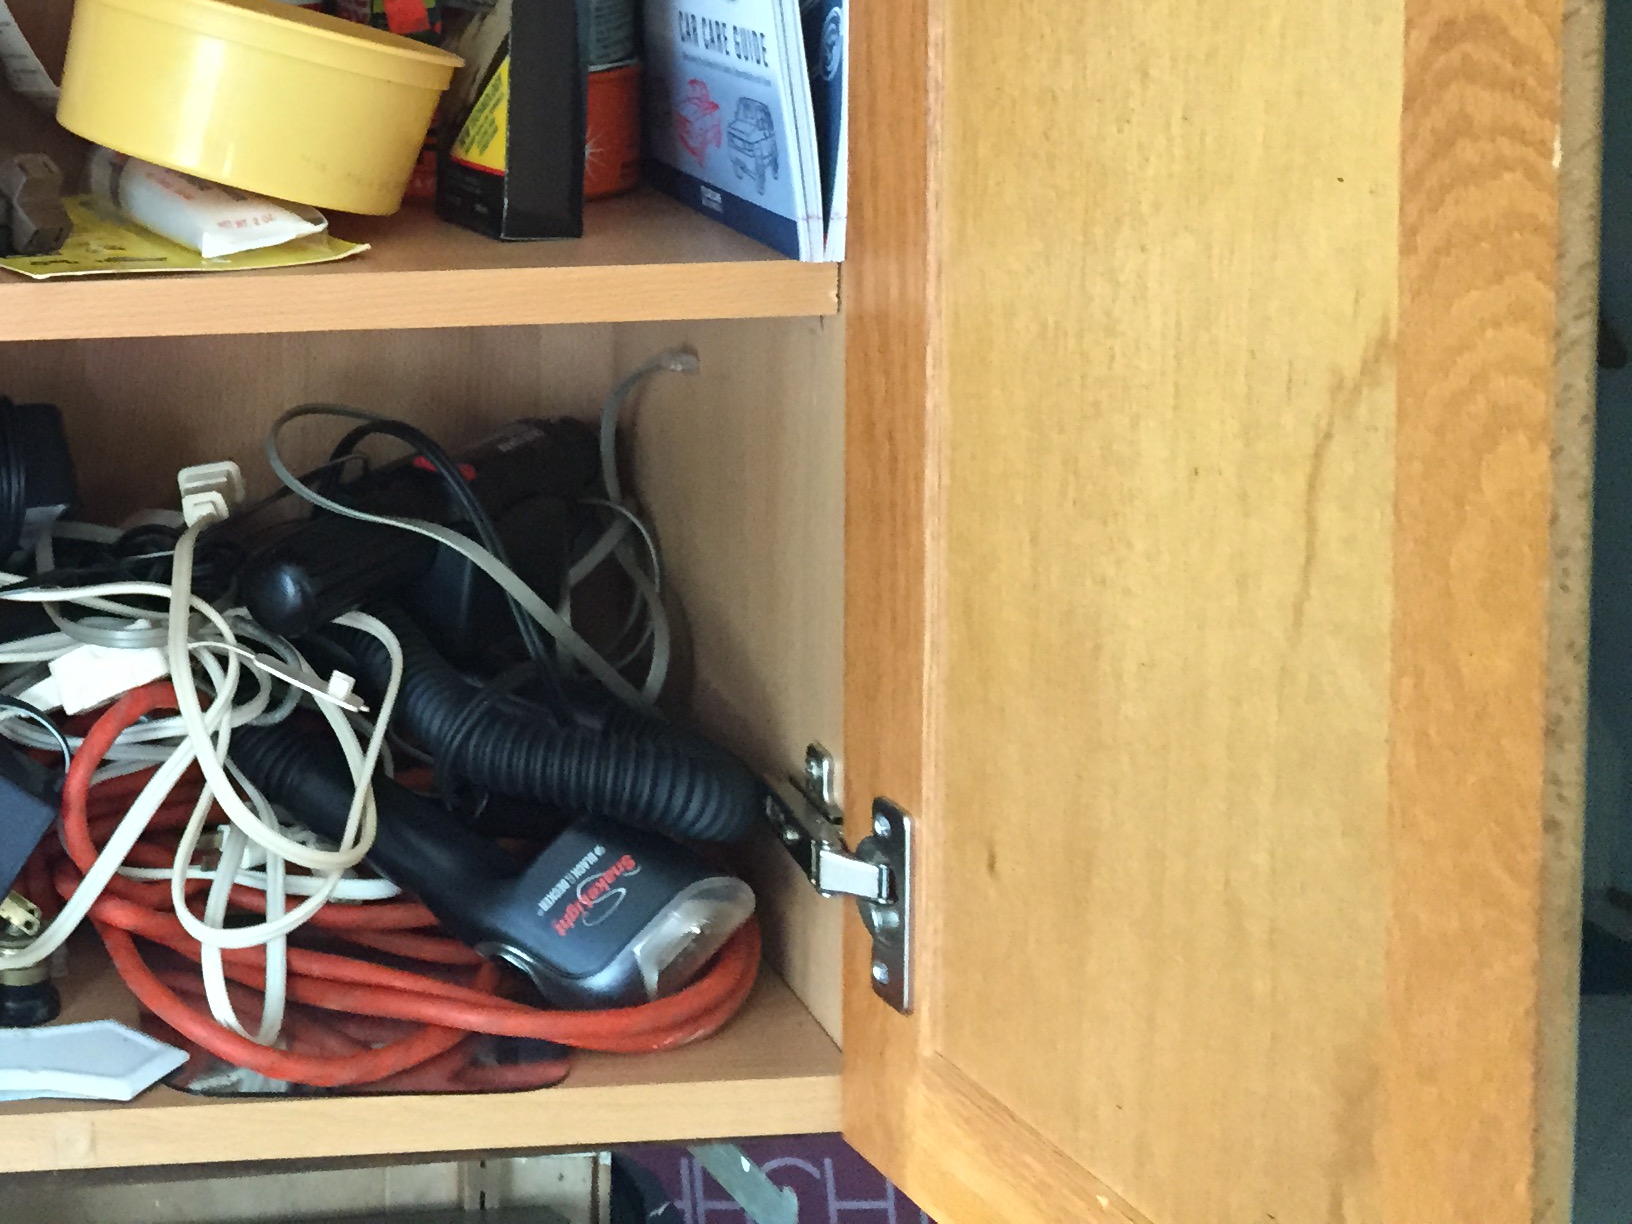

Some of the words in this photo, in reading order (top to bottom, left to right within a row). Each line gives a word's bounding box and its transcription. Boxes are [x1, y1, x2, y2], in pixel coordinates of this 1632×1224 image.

[678, 10, 700, 48] CAR
[701, 16, 730, 56] CARE
[732, 25, 769, 68] GUIDE
